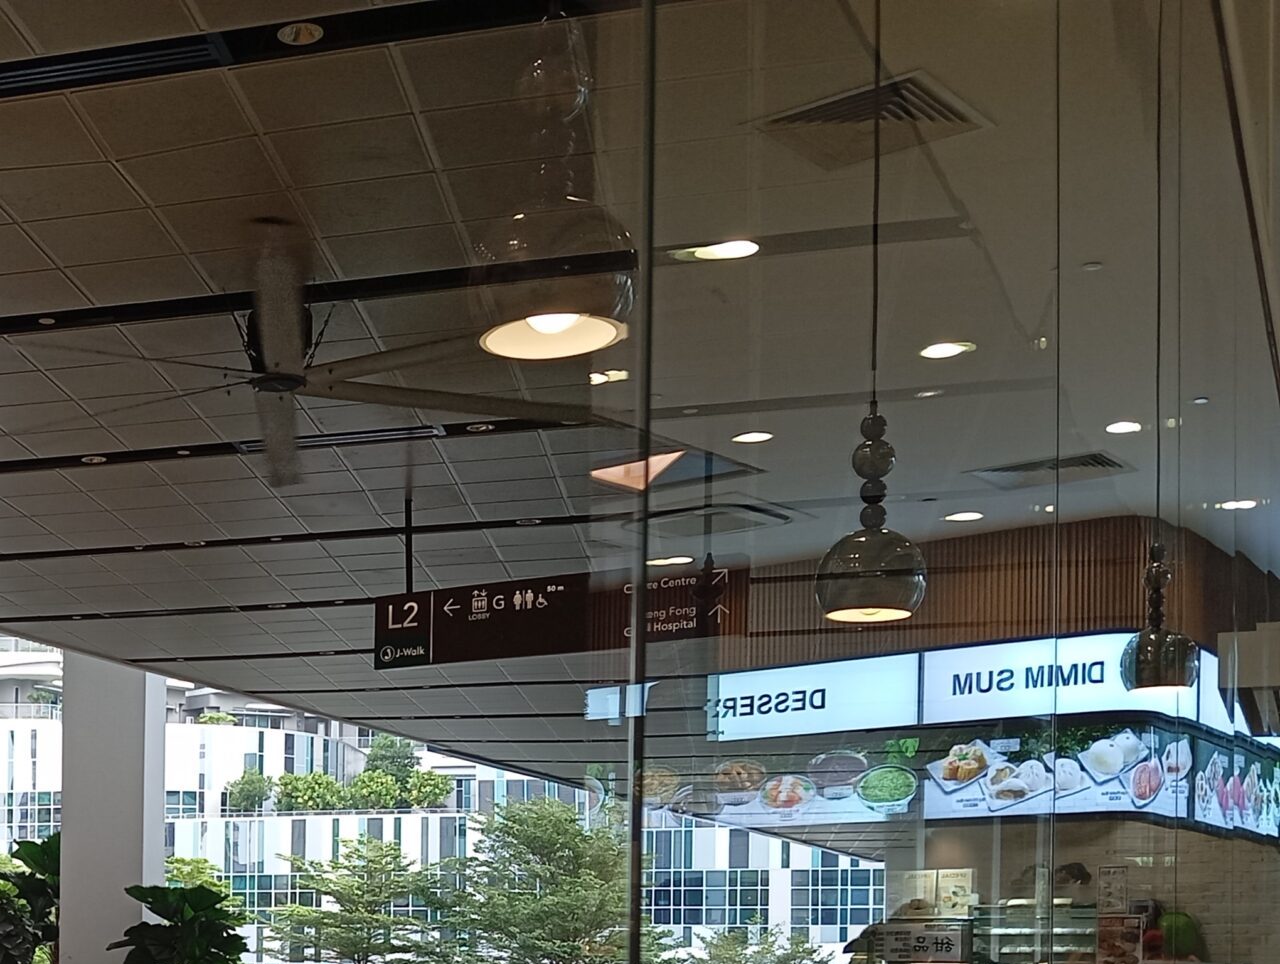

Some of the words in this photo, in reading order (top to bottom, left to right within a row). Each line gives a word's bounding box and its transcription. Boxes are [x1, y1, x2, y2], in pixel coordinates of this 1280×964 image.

[547, 584, 556, 592] 50
[660, 577, 697, 588] Centre
[492, 595, 505, 610] G
[387, 601, 418, 629] L2
[669, 606, 697, 617] Fong
[653, 618, 697, 632] Hospital
[395, 646, 425, 658] J-Walk
